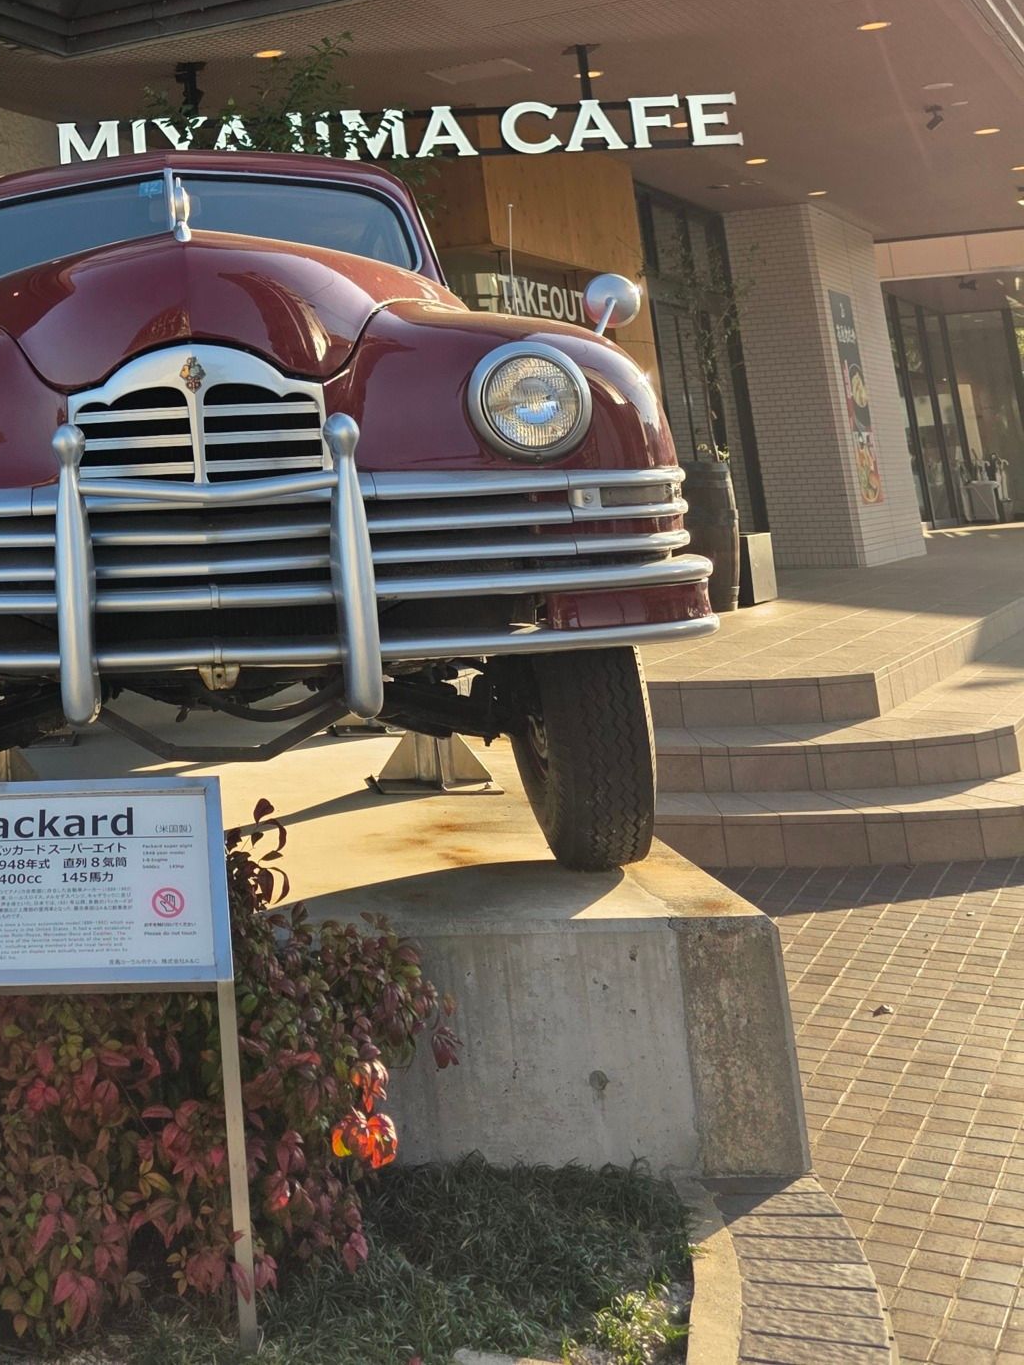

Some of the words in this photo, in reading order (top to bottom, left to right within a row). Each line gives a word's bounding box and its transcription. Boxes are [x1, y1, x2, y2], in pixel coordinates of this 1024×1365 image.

[501, 92, 744, 154] CAFE
[497, 274, 586, 323] TAKEOUT
[48, 842, 127, 854] スーパーエイト
[62, 871, 114, 883] 145馬力
